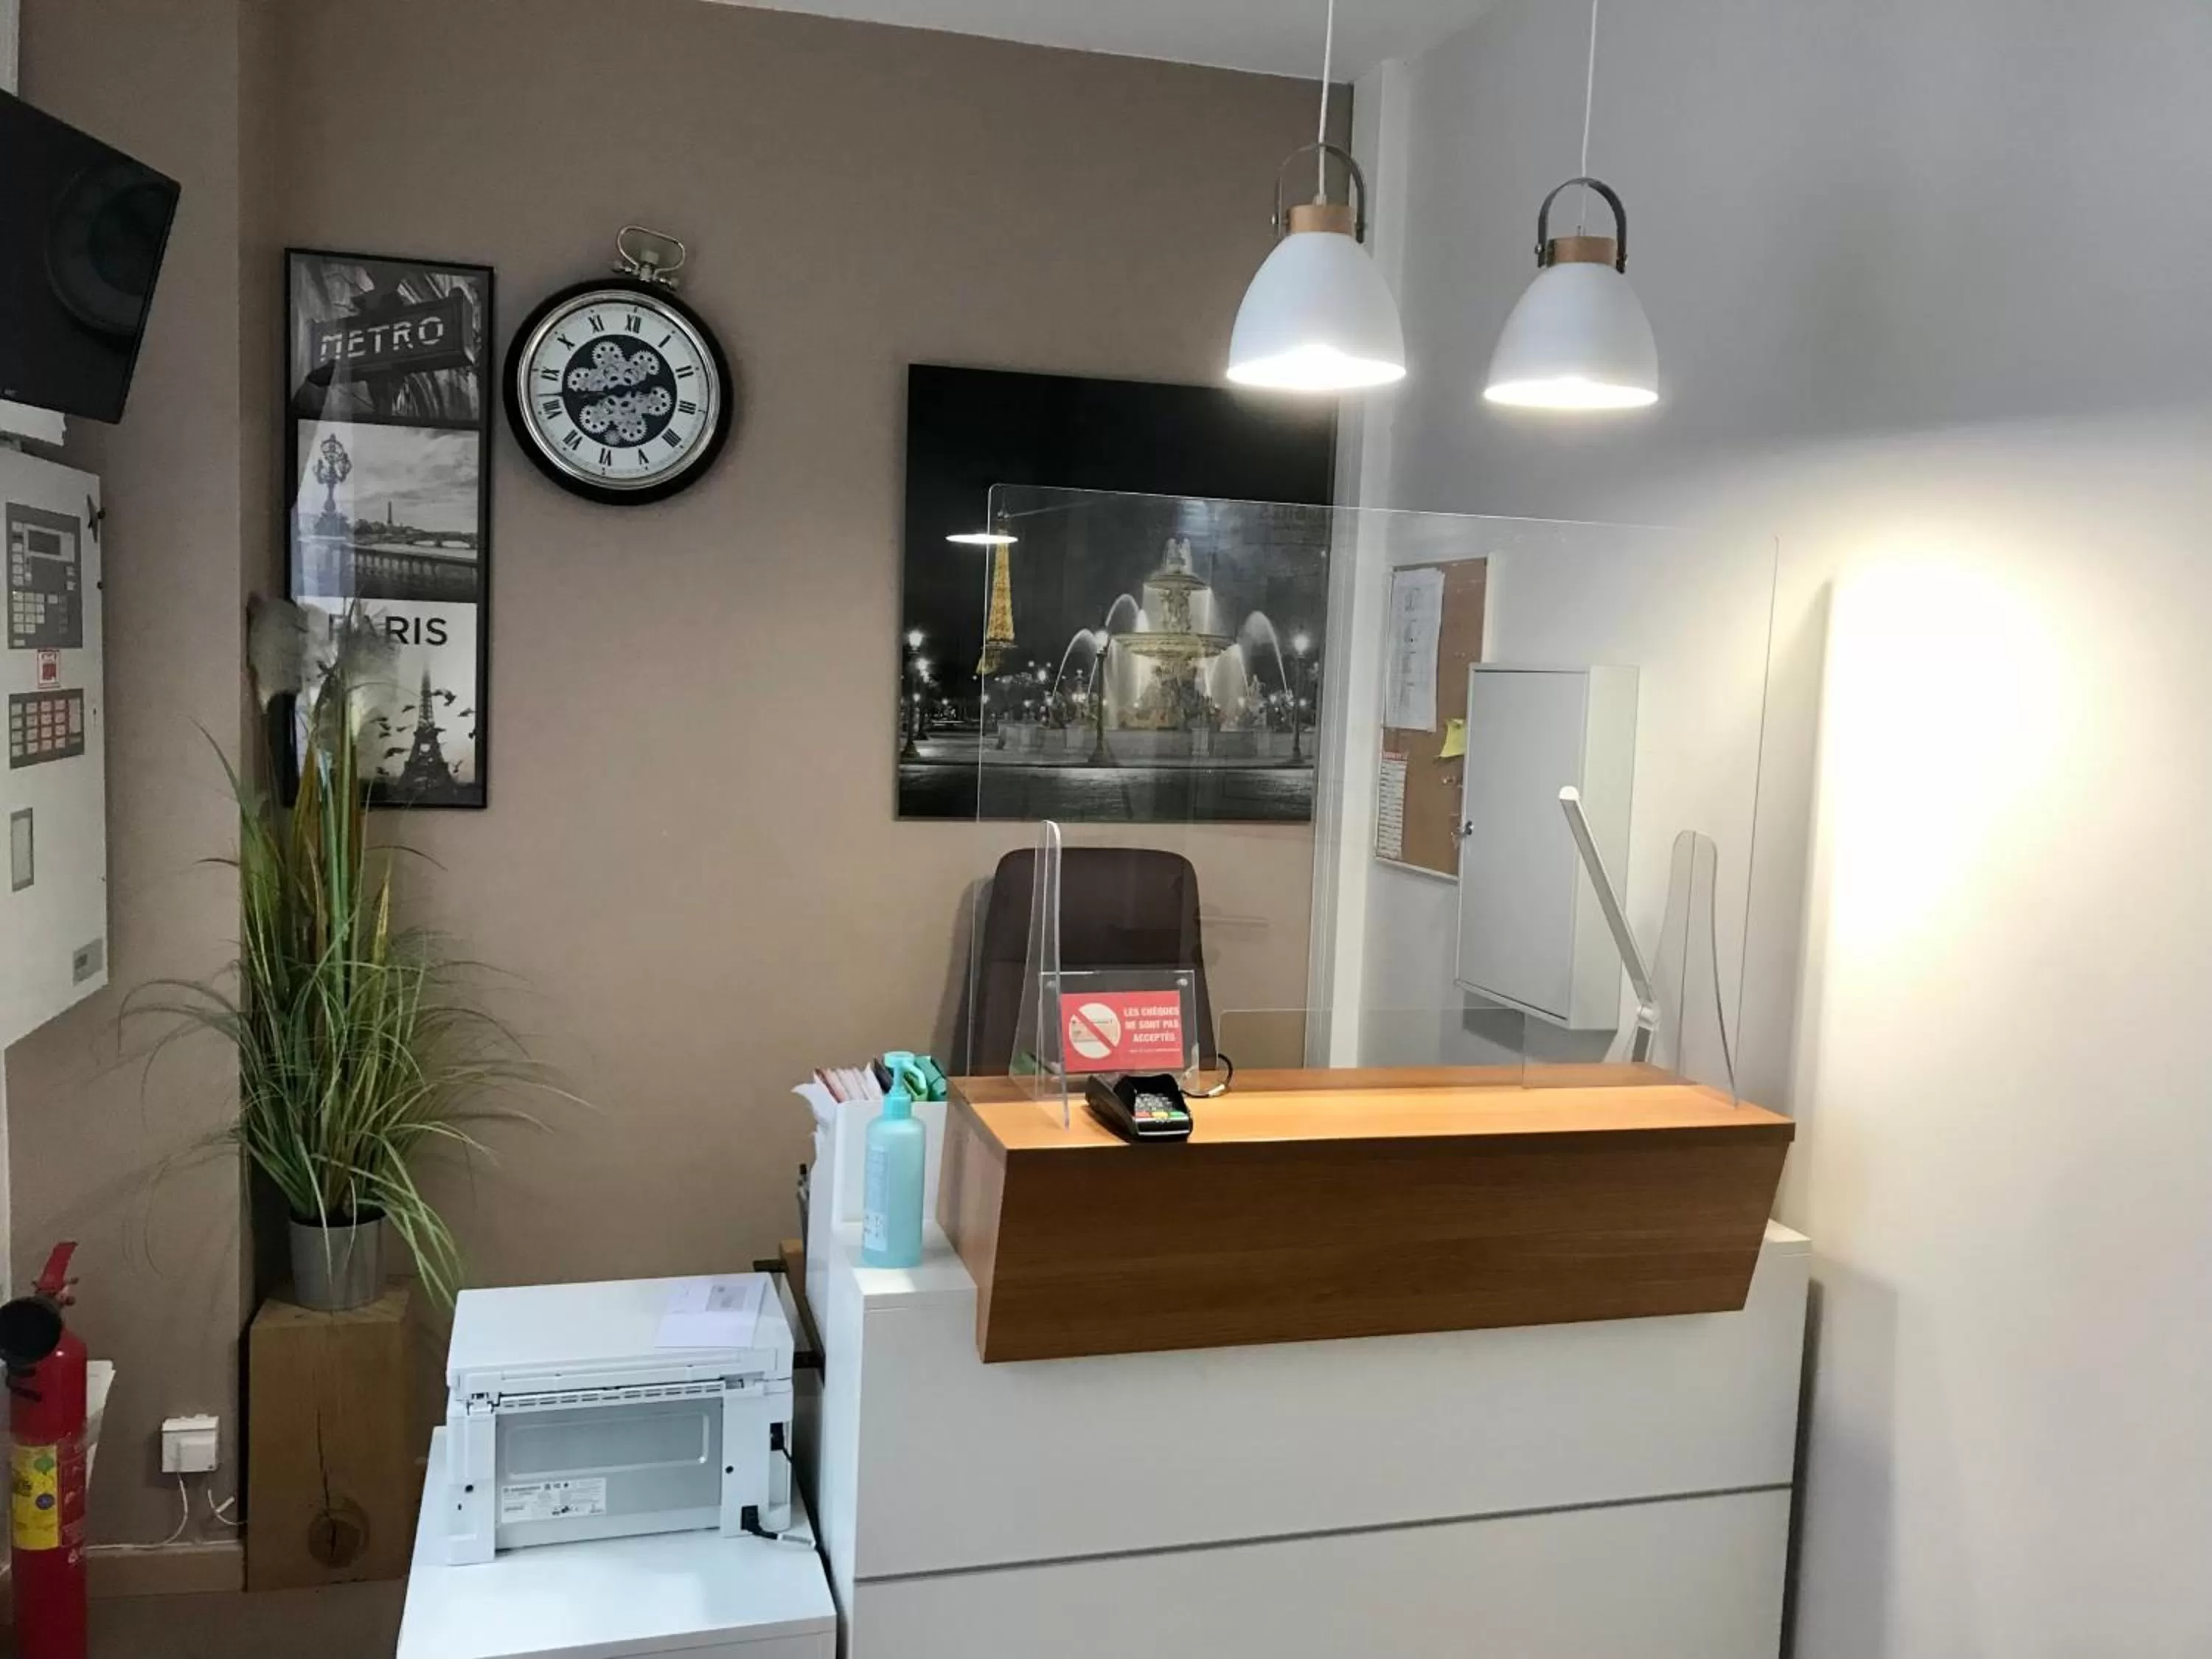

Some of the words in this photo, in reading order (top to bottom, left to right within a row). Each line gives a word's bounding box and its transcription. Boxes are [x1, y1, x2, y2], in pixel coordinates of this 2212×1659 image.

[588, 315, 605, 333] XI
[625, 314, 641, 333] XII
[557, 333, 575, 350] X
[1123, 1007, 1139, 1017] LES
[1124, 1020, 1136, 1030] NE
[1138, 1020, 1160, 1029] SONT
[1163, 1018, 1179, 1029] PAS
